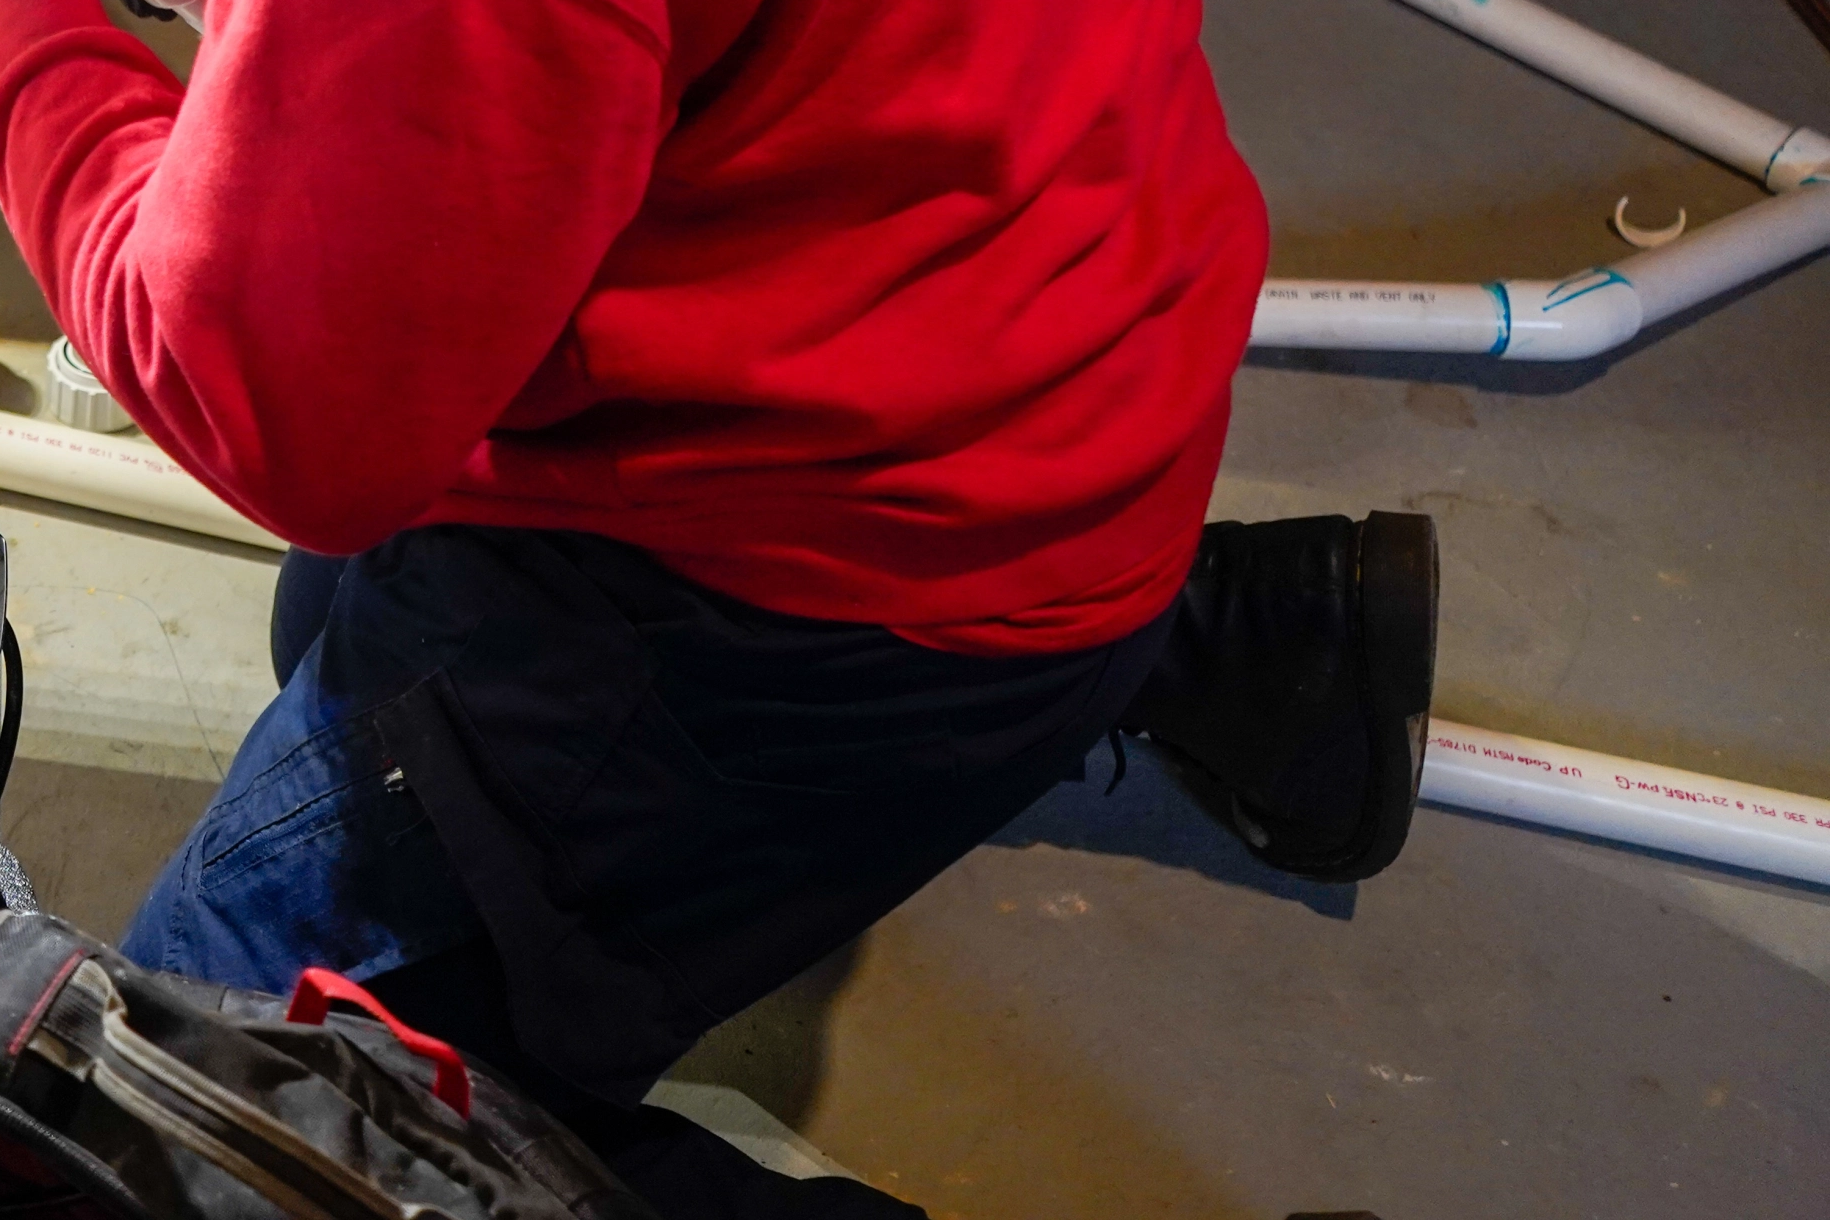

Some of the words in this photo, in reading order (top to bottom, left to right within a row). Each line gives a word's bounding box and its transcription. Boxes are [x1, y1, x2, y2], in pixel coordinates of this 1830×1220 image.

[118, 453, 139, 465] PVC
[1481, 746, 1515, 762] ASTM
[1750, 803, 1777, 818] PSI
[1781, 809, 1806, 824] 330
